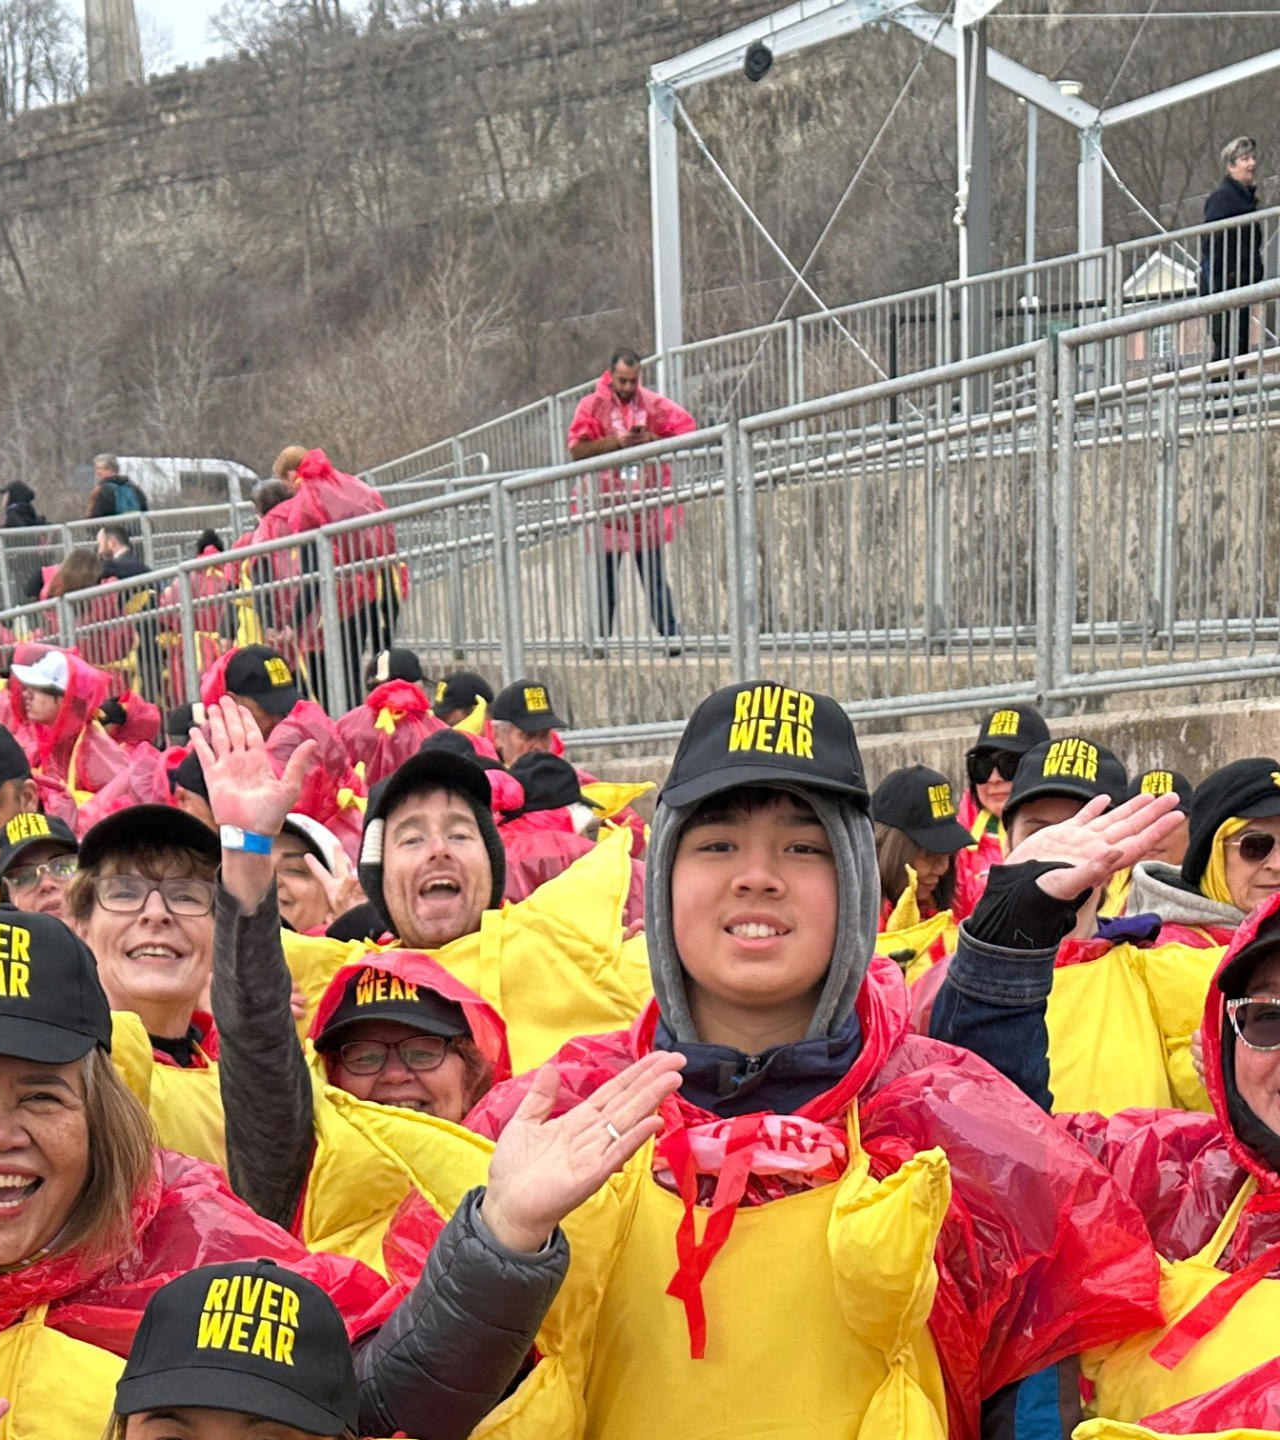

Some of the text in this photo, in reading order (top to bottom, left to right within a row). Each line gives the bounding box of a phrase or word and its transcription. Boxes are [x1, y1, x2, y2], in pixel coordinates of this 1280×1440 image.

[733, 686, 815, 730] RIVER
[728, 718, 815, 760] WEAR
[1046, 739, 1098, 765] RIVER
[1043, 756, 1098, 782] WEAR
[204, 1276, 300, 1328] RIVER
[197, 1312, 295, 1366] WEAR
